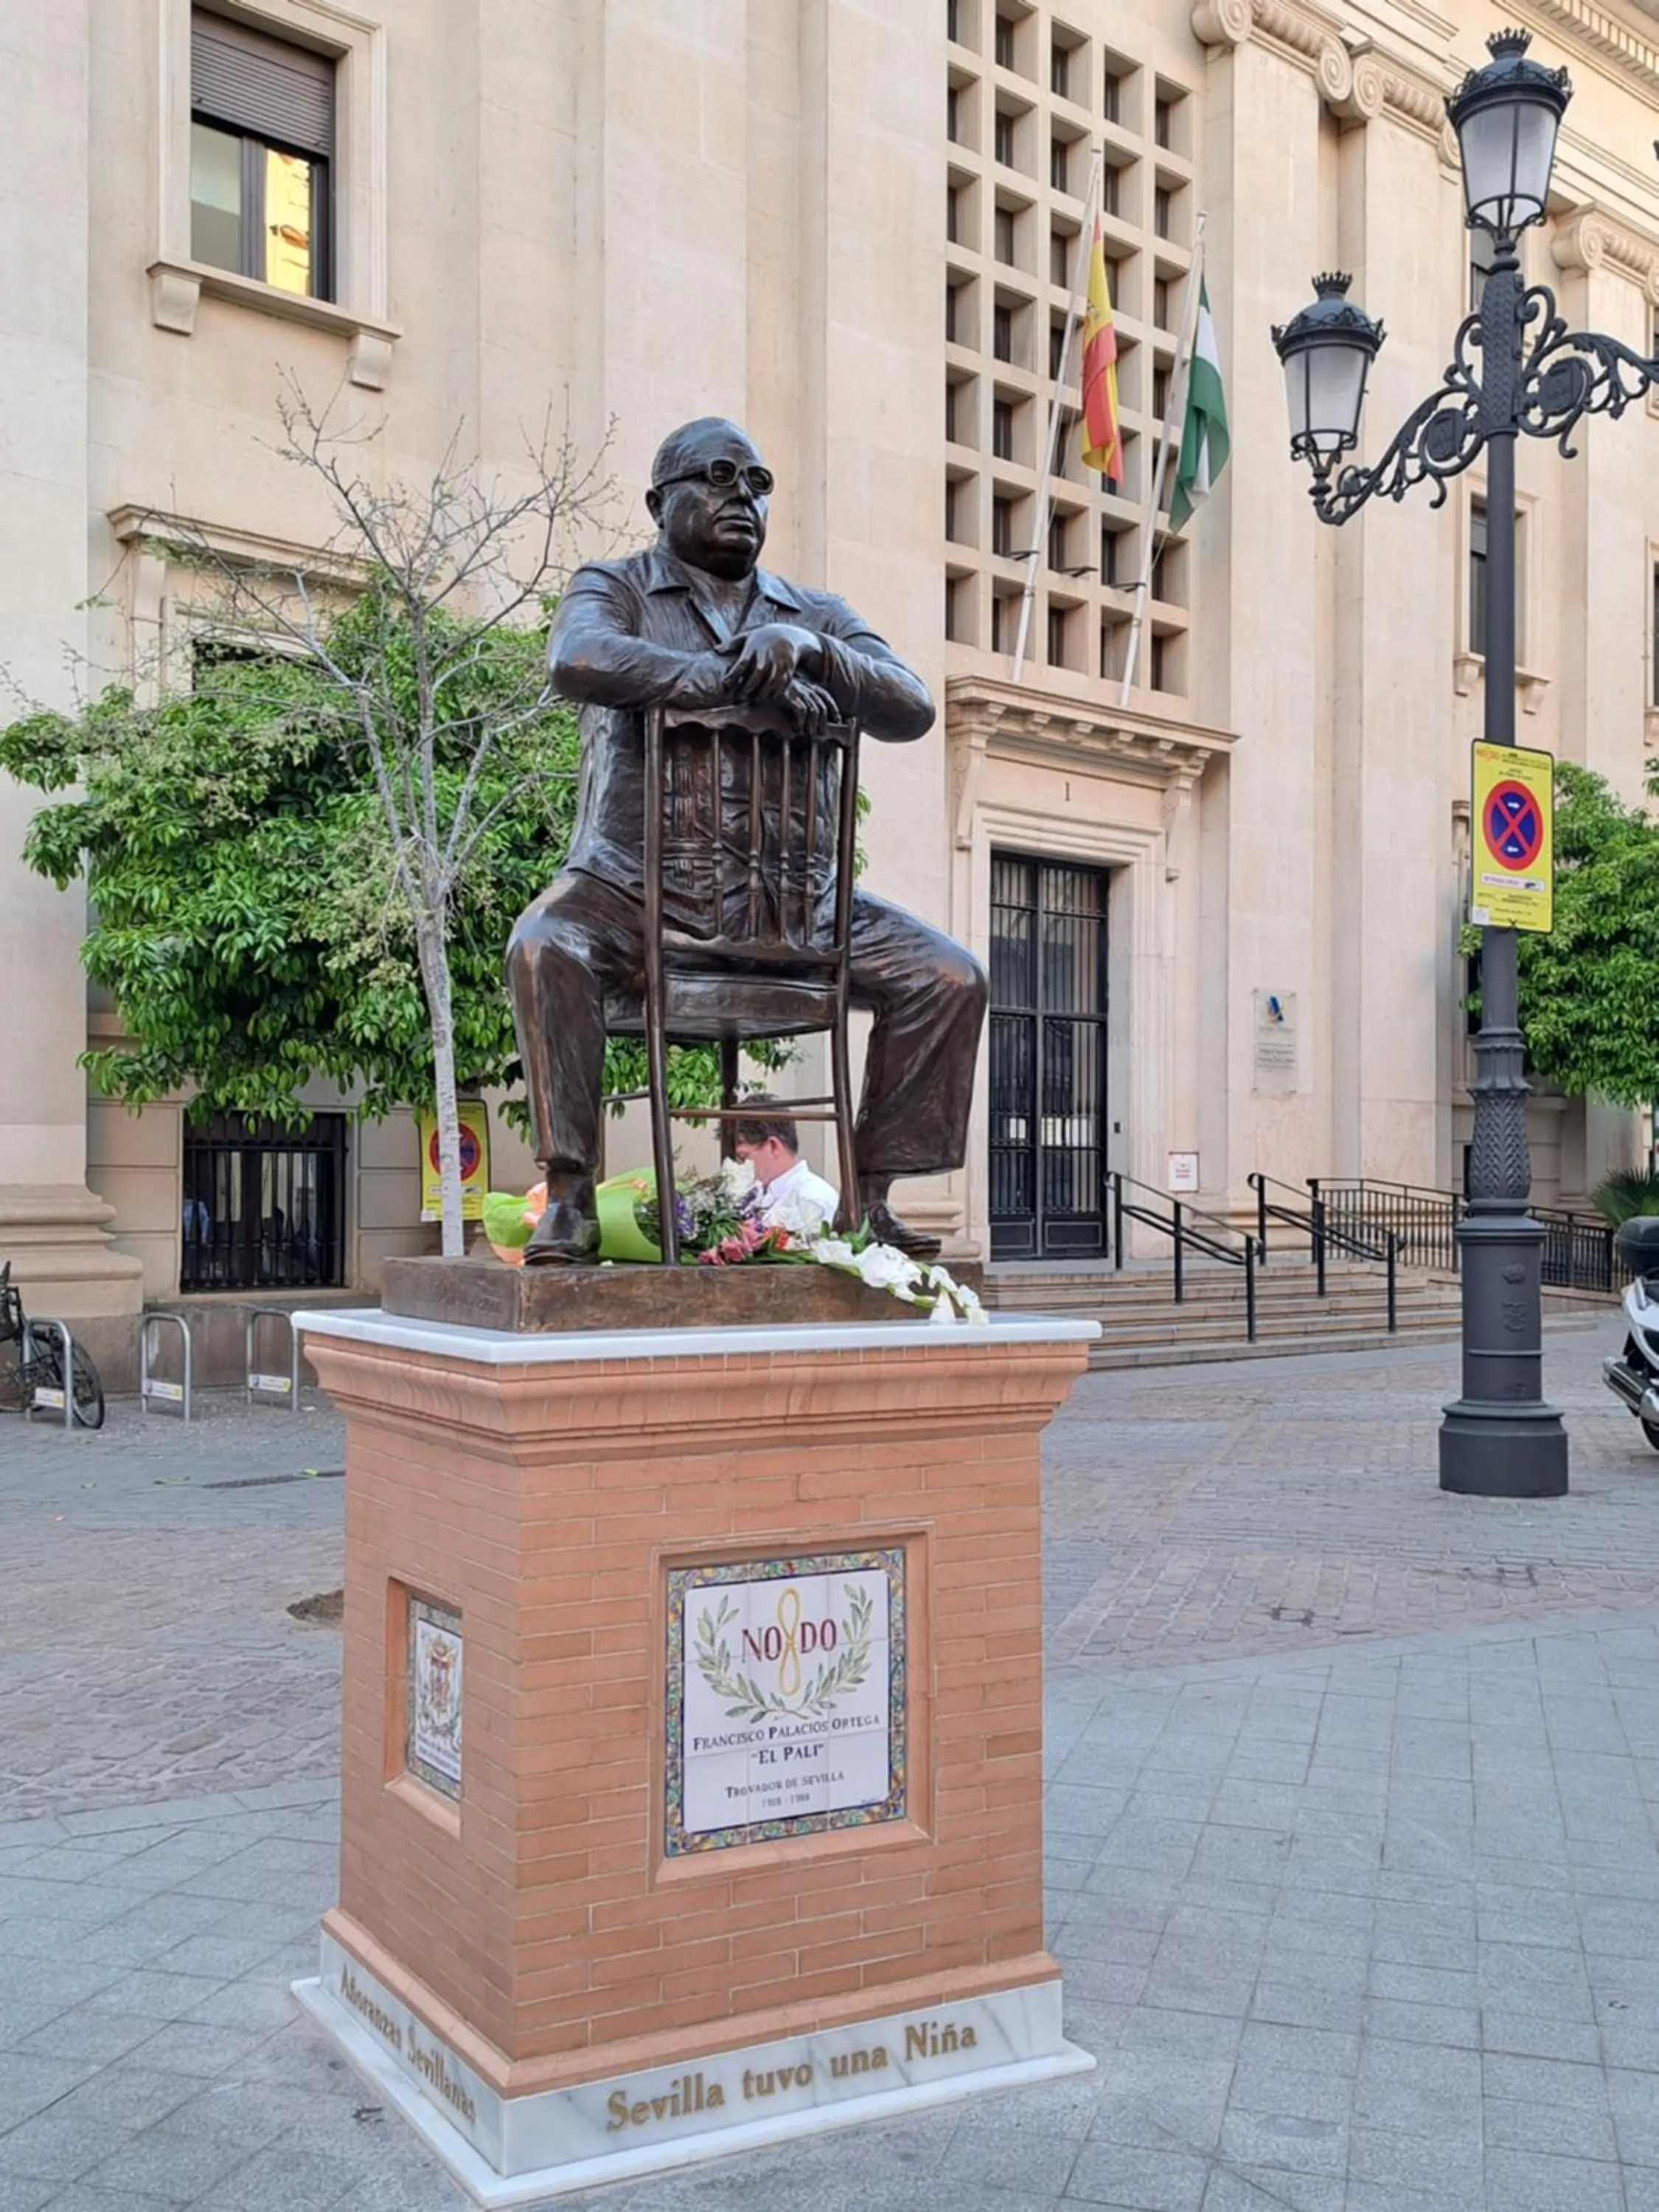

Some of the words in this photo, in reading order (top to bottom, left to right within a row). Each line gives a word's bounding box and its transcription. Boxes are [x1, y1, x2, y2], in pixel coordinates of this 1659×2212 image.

[693, 1729, 765, 1750] FRANCISCO
[768, 1721, 829, 1740] PALACIOS
[832, 1714, 880, 1731] ORTEGA
[726, 1779, 782, 1798] TROVADOR
[785, 1778, 799, 1790] DE
[801, 1770, 845, 1787] SEVILLA
[606, 2072, 725, 2132] Sevilla
[742, 2063, 813, 2101] tuvo
[829, 2045, 888, 2079] una
[903, 2021, 978, 2062] Niña
